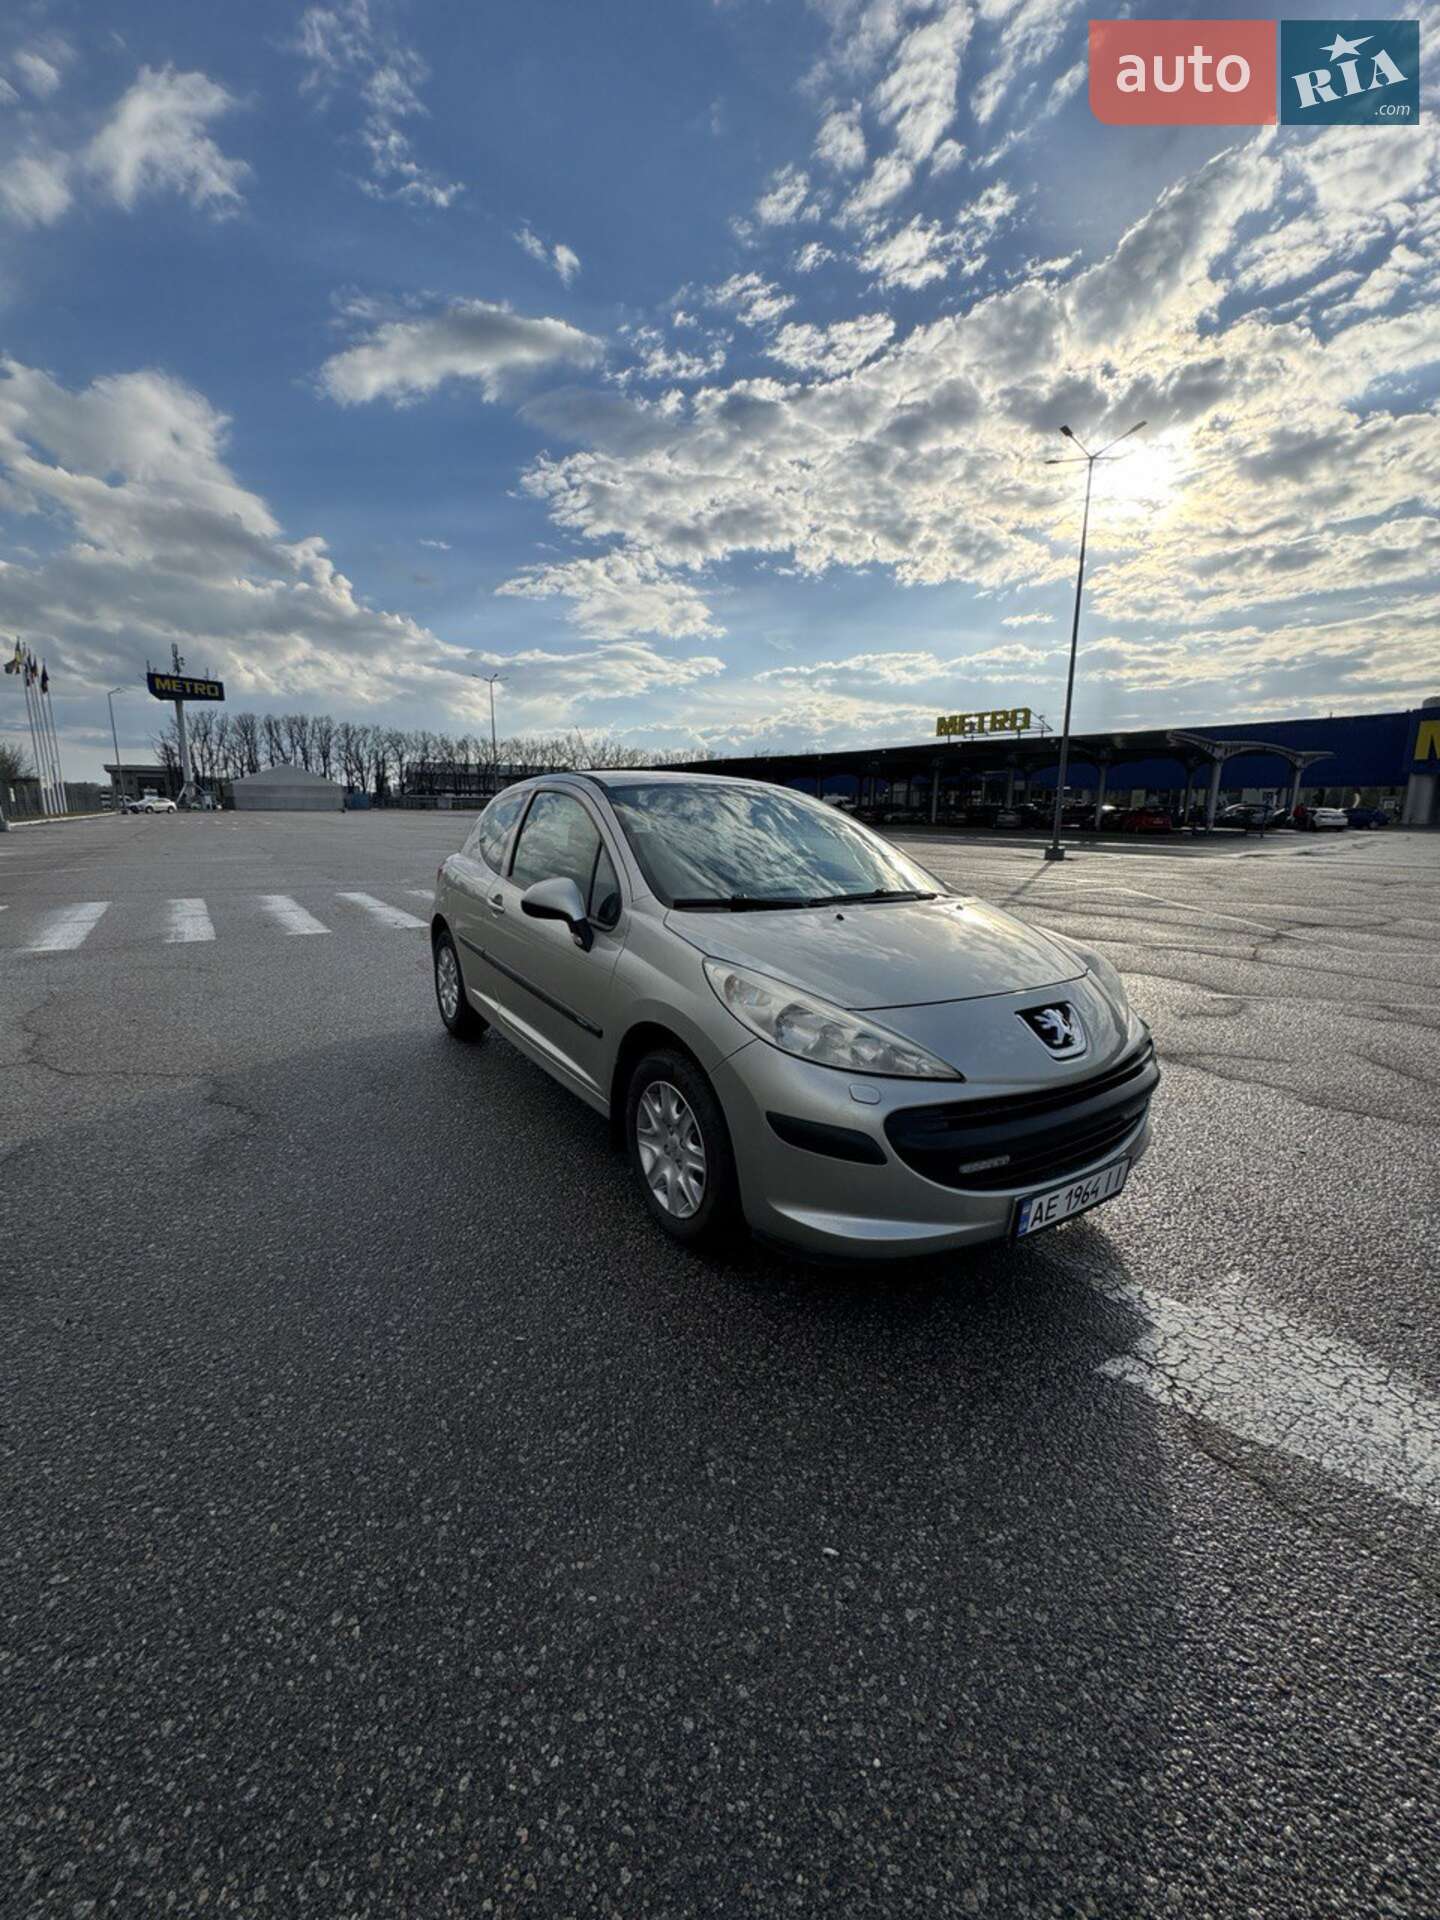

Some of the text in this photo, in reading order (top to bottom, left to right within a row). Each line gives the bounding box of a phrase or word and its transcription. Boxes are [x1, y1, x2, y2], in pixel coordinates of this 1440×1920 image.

[154, 677, 220, 697] METRO
[936, 707, 1032, 737] METRO
[1030, 1195, 1060, 1228] AE
[1065, 1178, 1101, 1212] 1964
